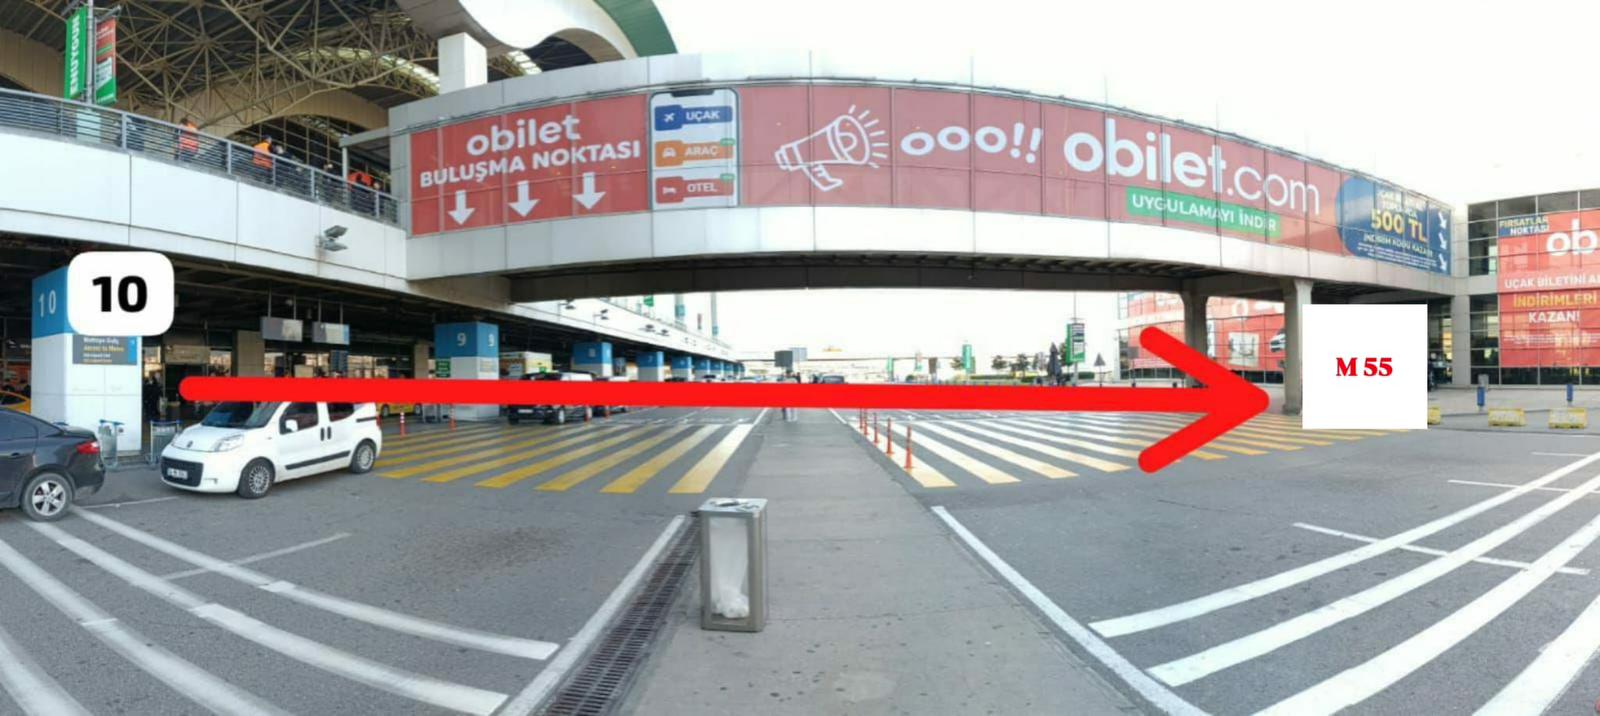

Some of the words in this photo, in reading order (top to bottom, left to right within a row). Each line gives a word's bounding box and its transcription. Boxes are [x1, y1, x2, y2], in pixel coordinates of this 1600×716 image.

[70, 14, 80, 96] ENUYGUN
[686, 110, 720, 122] UÇAK
[466, 114, 581, 157] obilet
[900, 122, 1043, 164] ooo!!
[419, 155, 525, 188] BULUŞMA
[532, 140, 641, 169] NOKTASI
[1063, 118, 1321, 216] obilet.com
[687, 182, 718, 193] OTEL
[1131, 193, 1235, 224] UYGULAMAYI
[1370, 208, 1404, 235] 500
[1408, 218, 1428, 243] TL
[1504, 277, 1535, 289] UÇAK
[38, 290, 56, 317] 10
[1513, 291, 1597, 308] İNDİRİMLERİ
[1528, 310, 1580, 323] KAZAN!
[456, 332, 467, 347] 9
